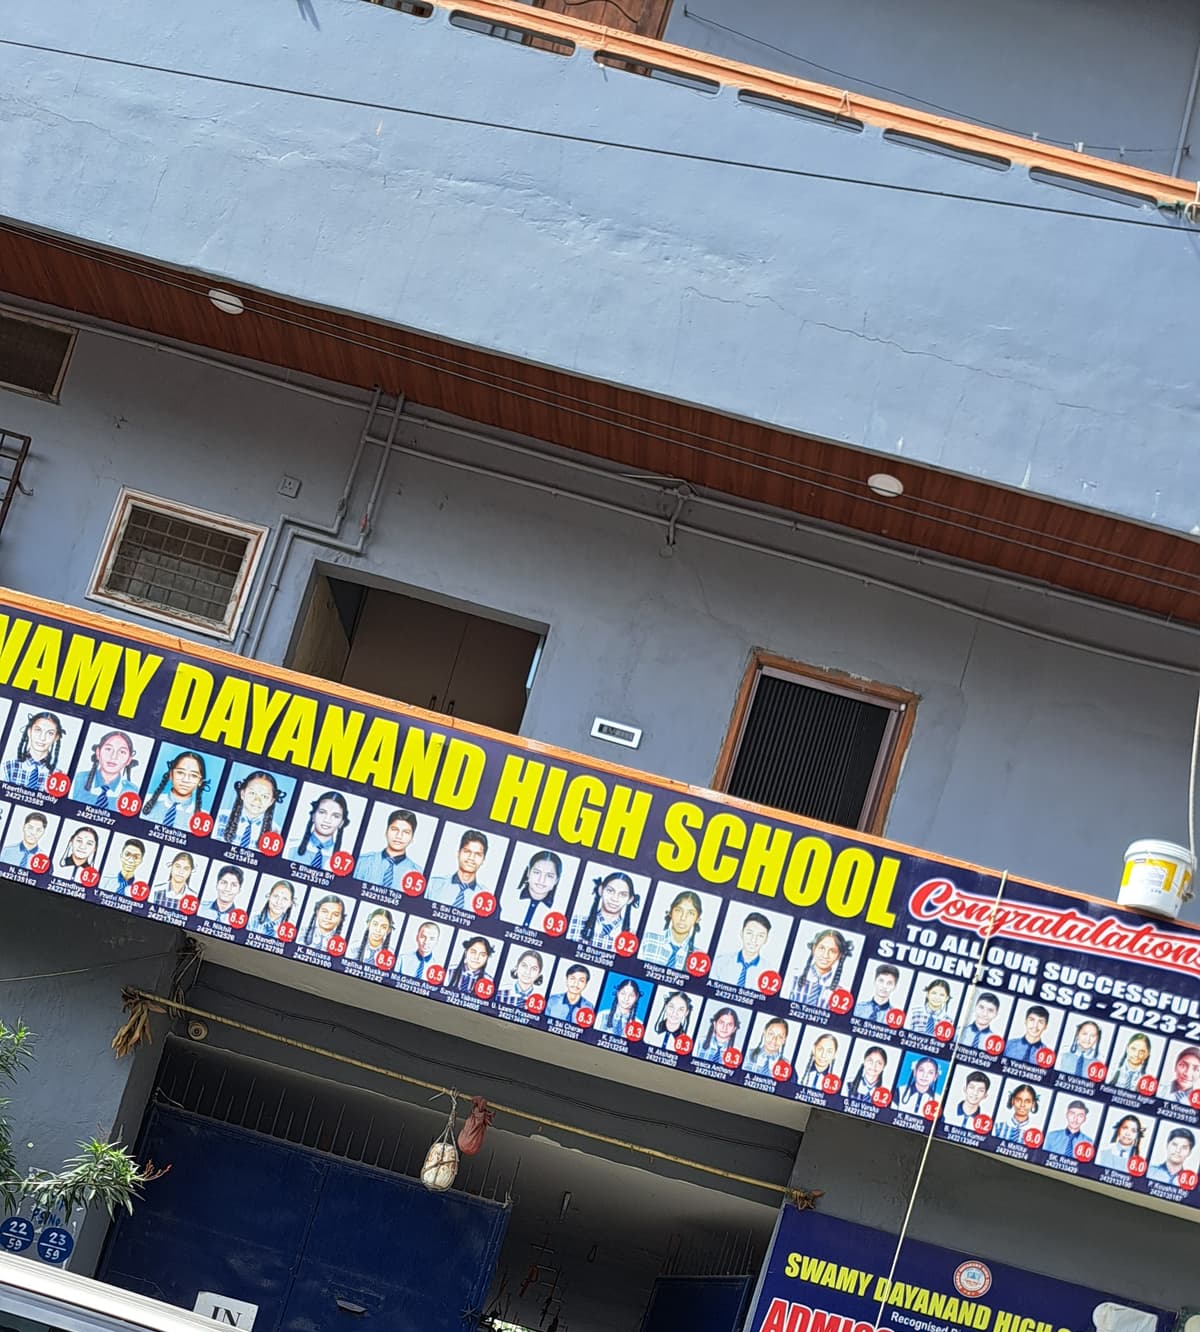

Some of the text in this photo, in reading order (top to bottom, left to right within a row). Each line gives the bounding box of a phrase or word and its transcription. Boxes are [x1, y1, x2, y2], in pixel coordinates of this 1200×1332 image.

[48, 776, 67, 792] 9.8
[36, 792, 58, 804] Reddy
[160, 662, 487, 812] DAYANAND
[489, 753, 653, 860] HIGH
[655, 800, 902, 929] SCHOOL
[119, 796, 139, 812] 9.8
[191, 816, 211, 832] 9.8
[261, 835, 280, 851] 9.8
[32, 856, 48, 869] 8.7
[332, 855, 352, 871] 9.7
[81, 870, 96, 883] 8.7
[404, 875, 423, 891] 9.5
[131, 884, 146, 897] 8.7
[181, 898, 197, 911] 8.5
[474, 895, 493, 911] 9.3
[229, 911, 245, 924] 8.5
[451, 908, 475, 920] Charan
[545, 916, 565, 932] 9.3
[278, 925, 294, 938] 8.5
[328, 939, 344, 952] 8.5
[616, 936, 635, 952] 9.2
[377, 953, 392, 966] 8.5
[688, 956, 707, 972] 9.2
[427, 968, 442, 981] 8.5
[877, 936, 1005, 988] STUDENTS
[1008, 972, 1036, 996] IN
[1038, 980, 1092, 1011] SSC
[904, 923, 1200, 1019] TO ALL OUR SUCCESSFUL
[476, 982, 492, 994] 8.5
[760, 975, 779, 991] 9.2
[527, 997, 542, 1010] 8.3
[830, 994, 850, 1010] 9.2
[577, 1011, 592, 1023] 8.3
[887, 1013, 902, 1026] 9.0
[626, 1025, 642, 1038] 8.3
[936, 1025, 951, 1038] 9.0
[675, 1038, 690, 1051] 8.3
[986, 1039, 1001, 1052] 9.0
[724, 1052, 740, 1064] 8.3
[1037, 1052, 1052, 1064] 9.0
[773, 1065, 789, 1078] 8.3
[1089, 1066, 1104, 1078] 9.0
[822, 1078, 838, 1090] 8.3
[1140, 1079, 1154, 1091] 8.8
[872, 1090, 888, 1103] 8.2
[1191, 1091, 1200, 1103] 8.
[974, 1118, 990, 1131] 8.2
[1024, 1132, 1039, 1144] 8.0
[1075, 1146, 1091, 1158] 8.0
[1129, 1159, 1143, 1172] 8.0
[1179, 1172, 1194, 1186] 8.0
[9, 1221, 28, 1236] 22
[7, 1238, 23, 1250] 59
[49, 1232, 66, 1246] 23
[45, 1248, 60, 1260] 59
[784, 1252, 874, 1298] SWAMY
[873, 1276, 992, 1332] DAYANAND
[212, 1305, 243, 1327] IN
